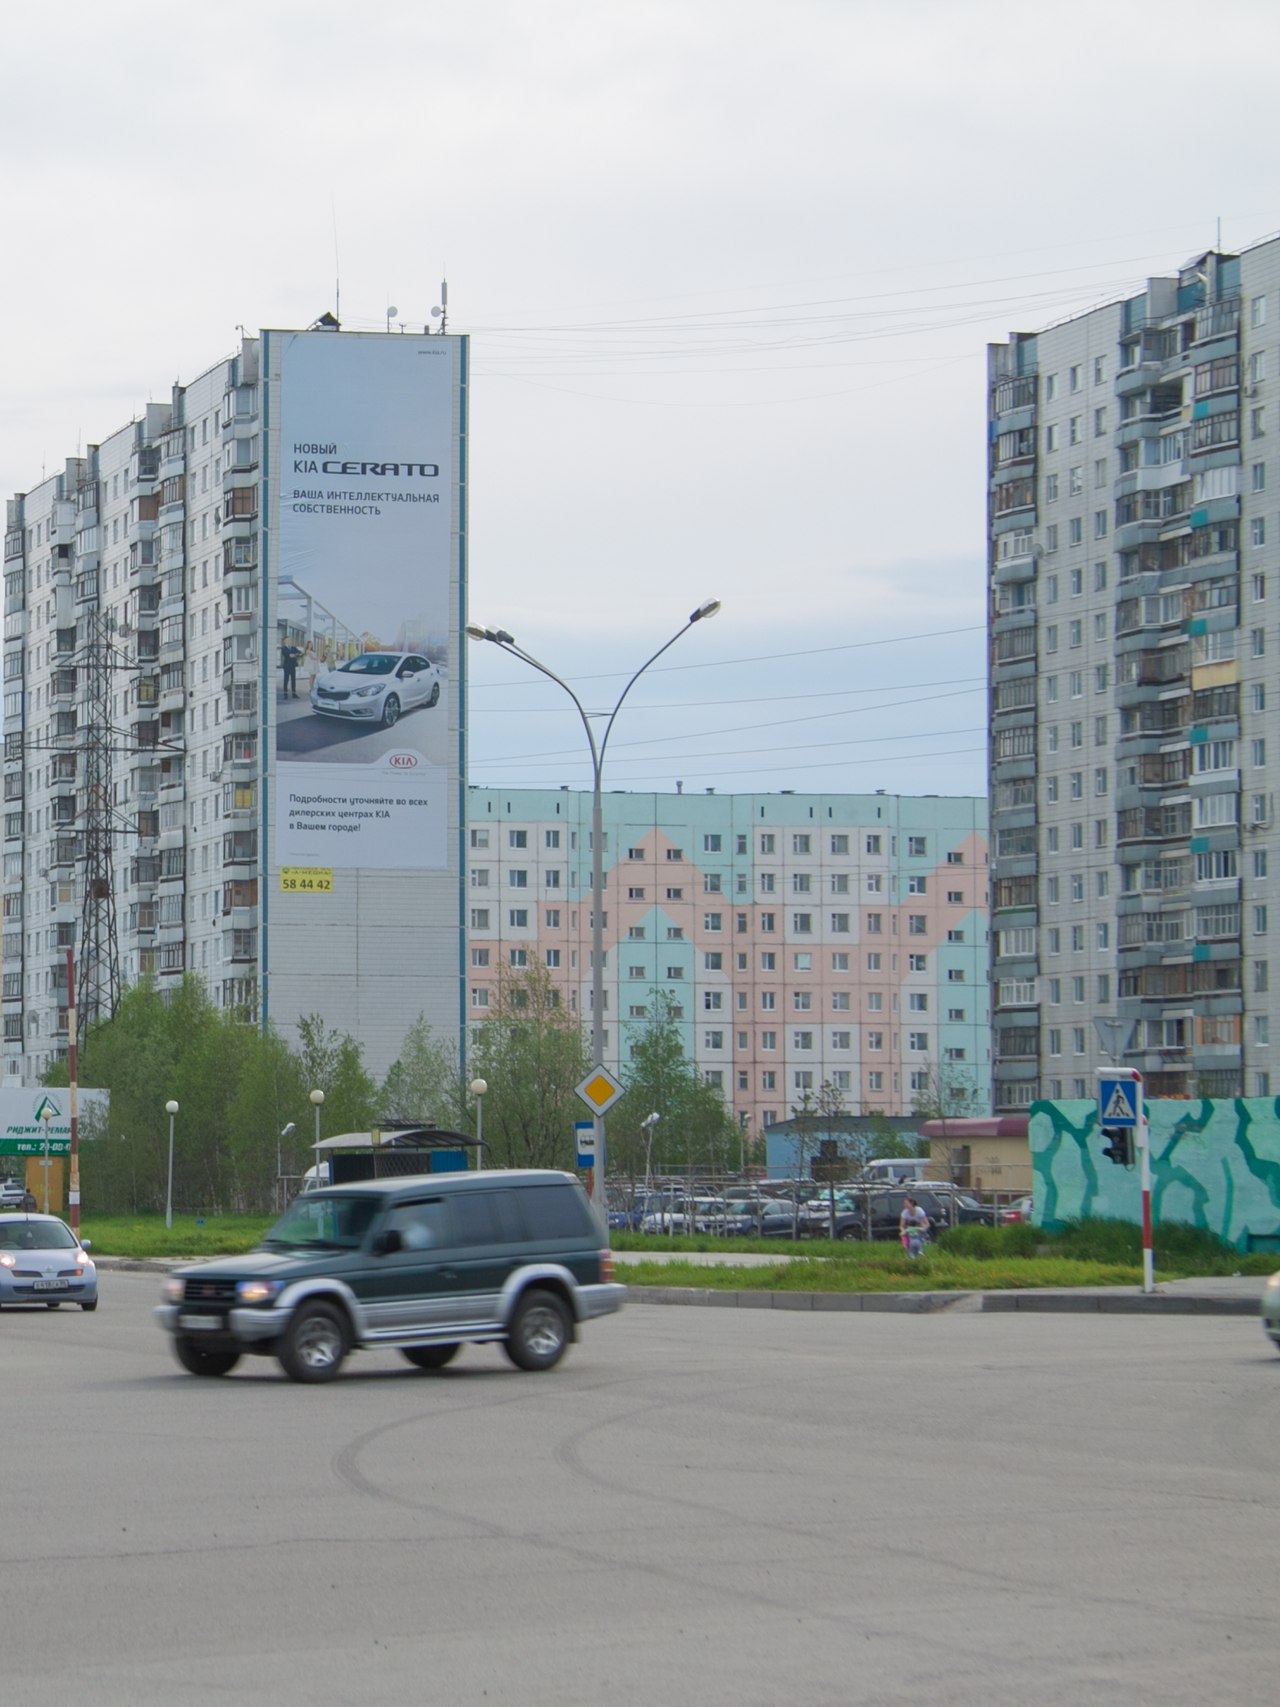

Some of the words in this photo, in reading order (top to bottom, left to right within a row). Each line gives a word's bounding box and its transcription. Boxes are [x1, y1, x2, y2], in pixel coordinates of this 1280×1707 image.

[293, 442, 337, 455] НОВЫЙ
[293, 460, 318, 473] KIA
[322, 461, 439, 477] CERATO
[293, 489, 324, 500] ВАША
[327, 491, 440, 503] ИНТЕЛЛЕКТУАЛЬНАЯ
[292, 503, 381, 516] СОБСТВЕННОСТЬ
[289, 793, 347, 805] Подробности
[349, 796, 394, 806] уточняйте
[396, 798, 406, 806] во
[408, 798, 428, 806] всех
[289, 808, 336, 818] дилерских
[338, 810, 374, 819] центрах
[375, 810, 391, 819] KIA
[289, 822, 294, 830] в
[296, 821, 326, 831] Вашем
[328, 822, 361, 833] городе!
[282, 878, 296, 890] 58
[299, 878, 314, 890] 44
[316, 879, 331, 890] 42
